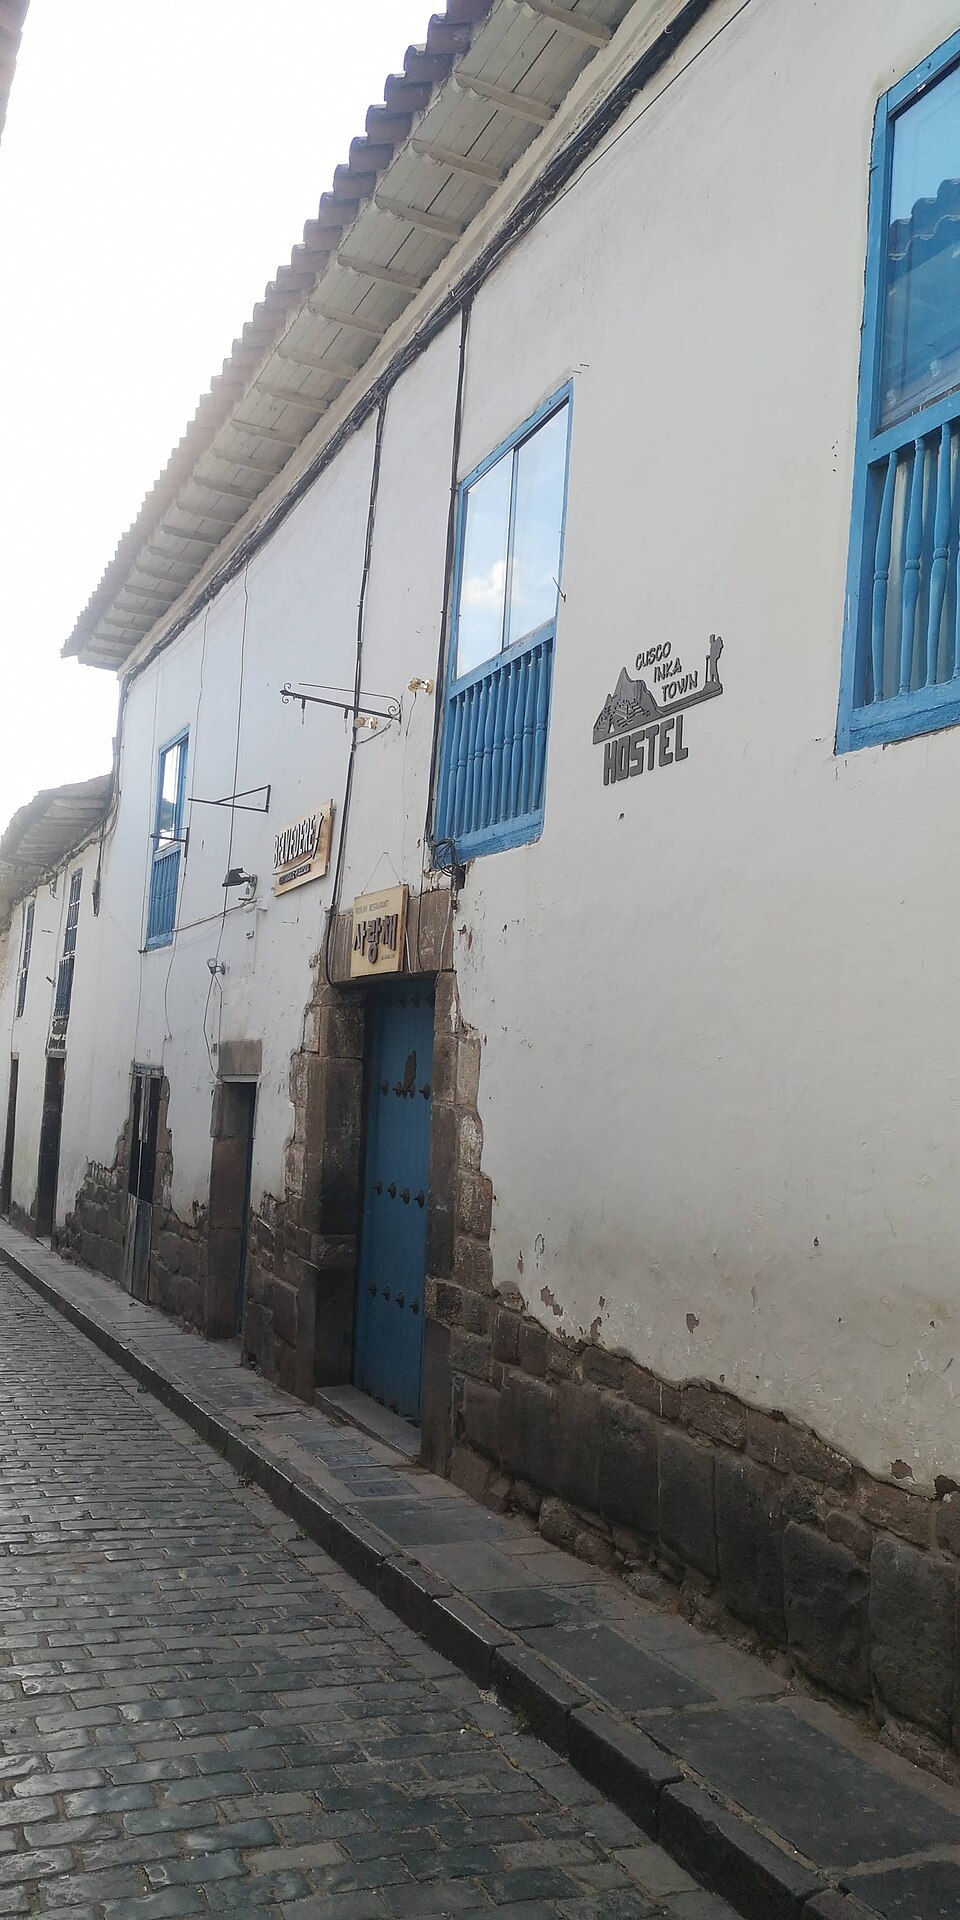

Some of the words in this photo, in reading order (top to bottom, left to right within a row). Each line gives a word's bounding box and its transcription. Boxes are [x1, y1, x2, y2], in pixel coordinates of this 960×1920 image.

[635, 641, 672, 671] CUSCO
[653, 657, 682, 684] INKA
[662, 671, 698, 702] TOWN
[603, 714, 689, 786] HOSTEL
[353, 914, 399, 965] 사랑채
